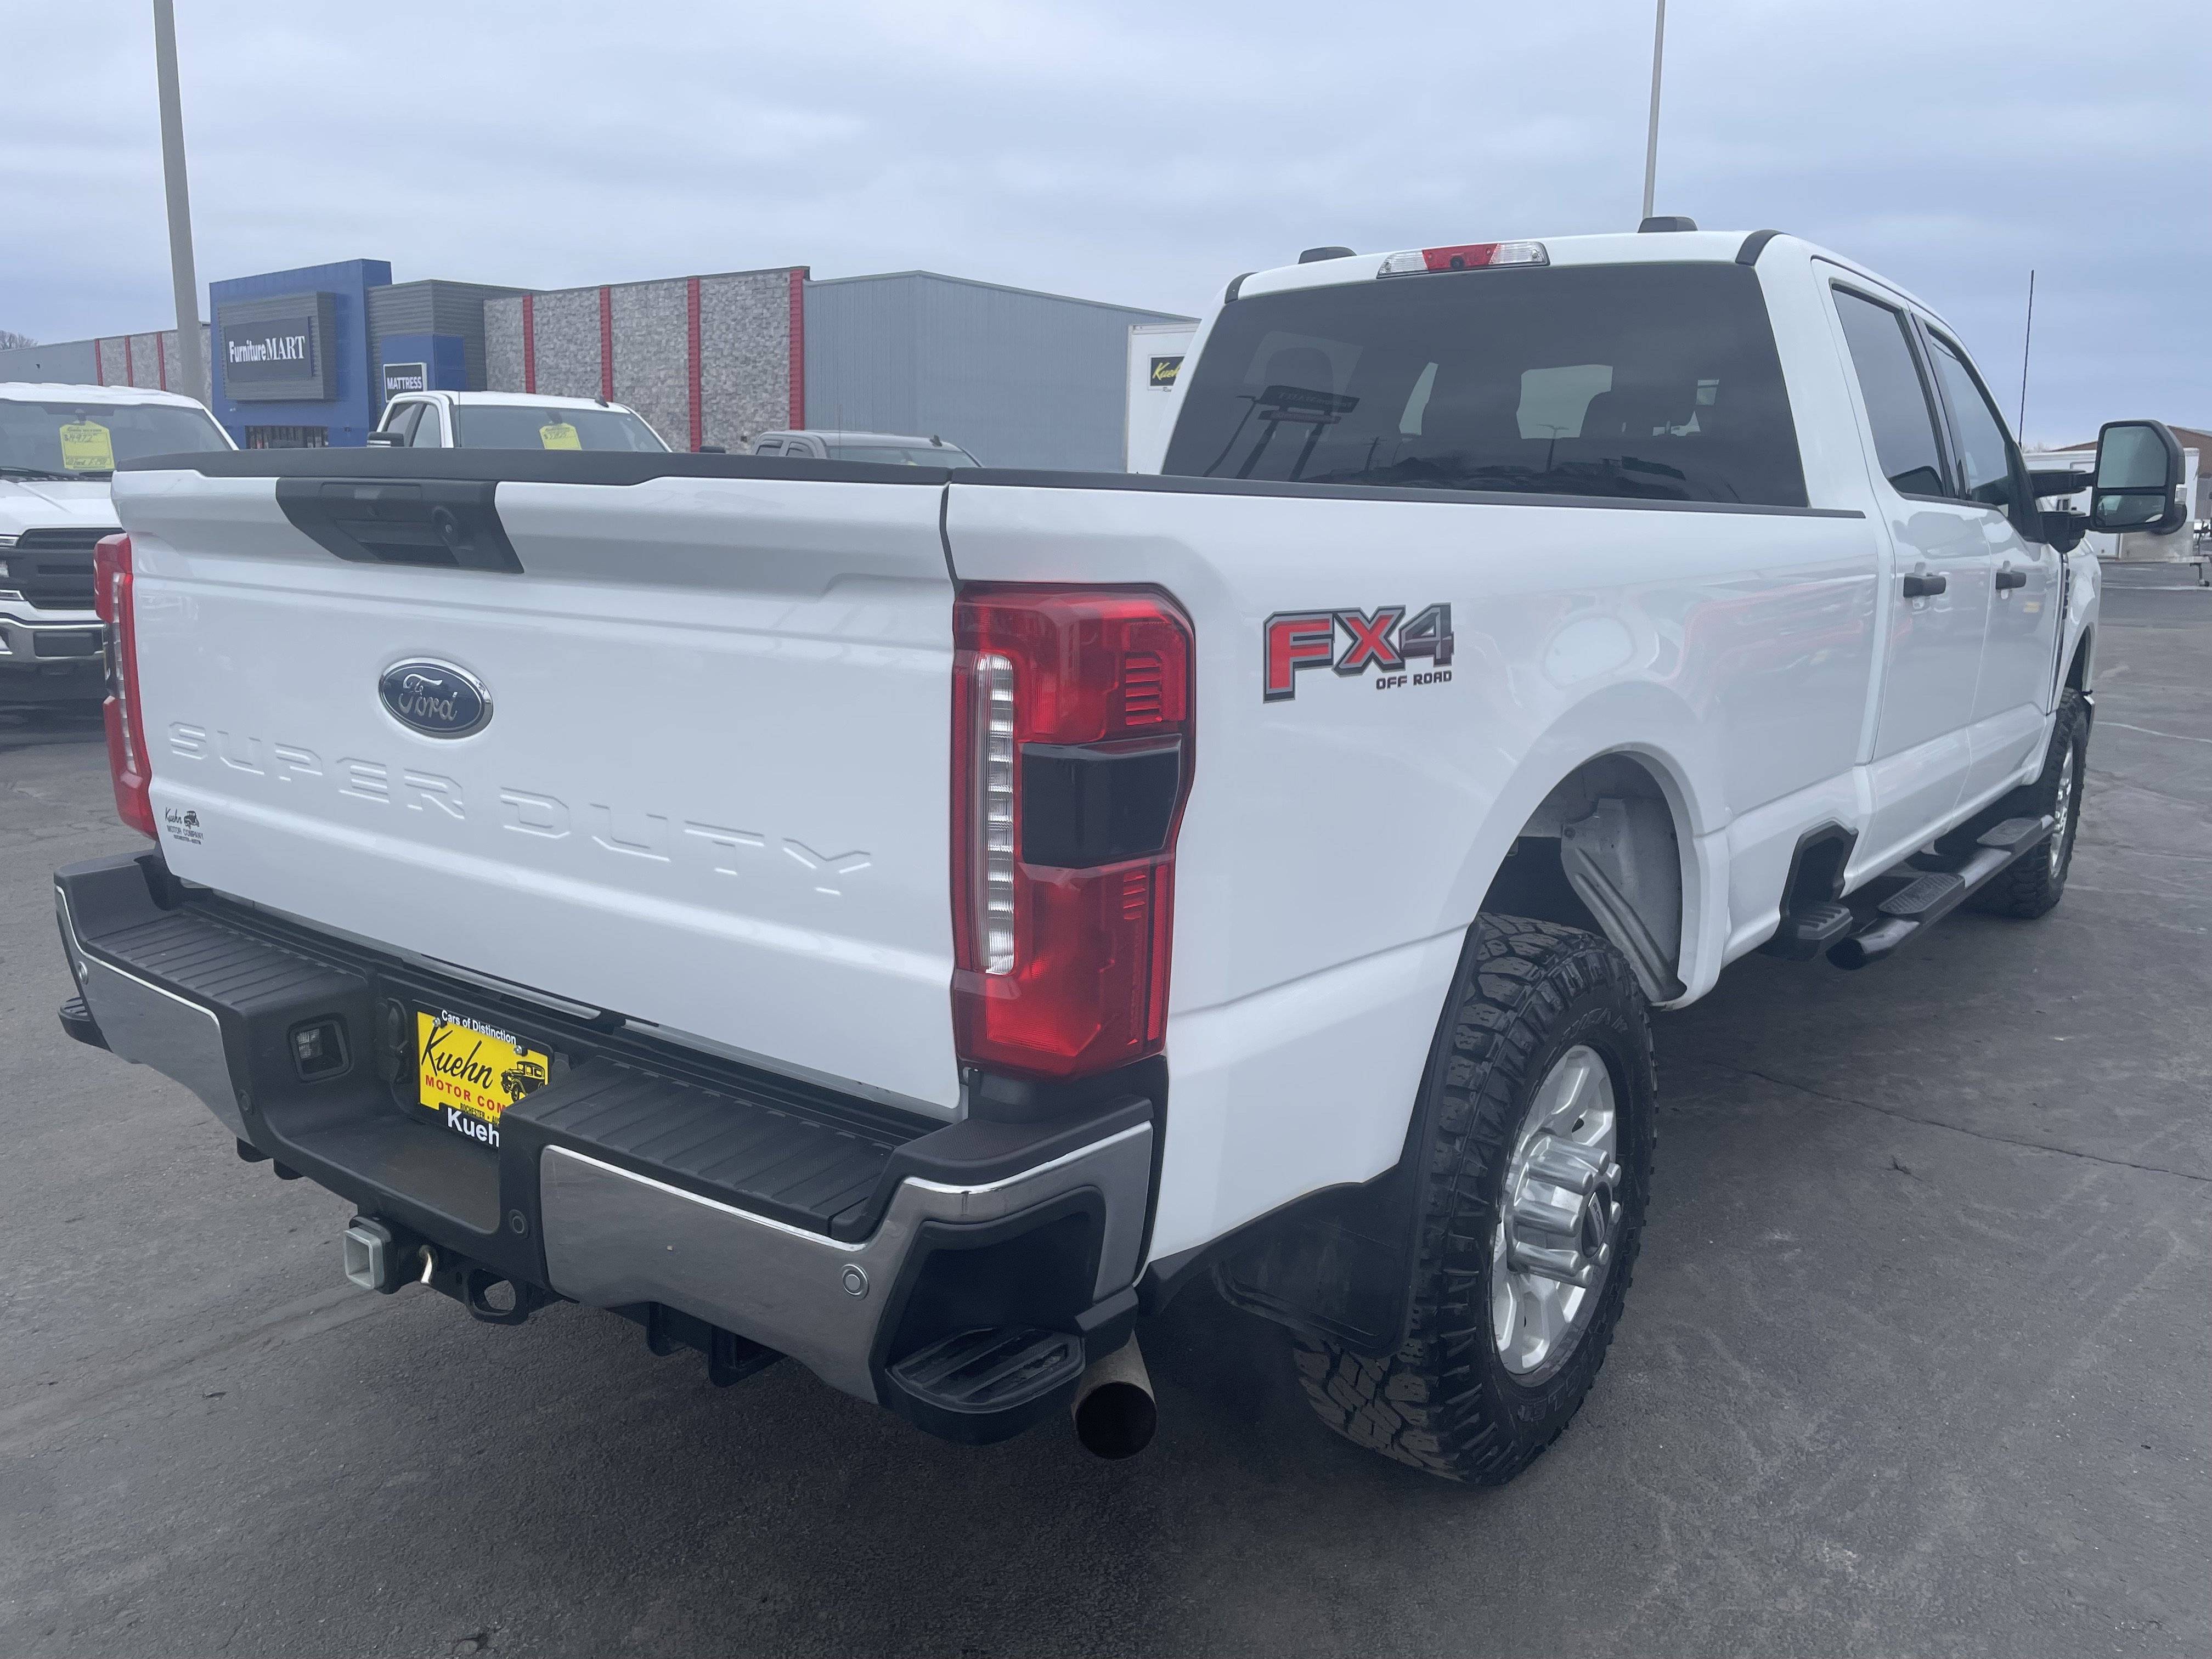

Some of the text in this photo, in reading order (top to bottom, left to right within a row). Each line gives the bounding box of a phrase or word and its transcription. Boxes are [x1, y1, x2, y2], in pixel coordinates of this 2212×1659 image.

[229, 336, 305, 363] FurnitureMART
[387, 376, 422, 390] MATTRESS
[1263, 602, 1454, 704] FX4
[1376, 670, 1452, 690] OFF ROAD
[398, 673, 458, 721] Ford
[165, 807, 183, 824] Kuehn
[169, 721, 872, 896] SUPER DUTY
[442, 1009, 517, 1046] Cars of Distinction
[421, 1025, 493, 1089] Kuehn
[425, 1075, 471, 1102] MOTOR
[460, 1103, 485, 1120] ROCHESTER
